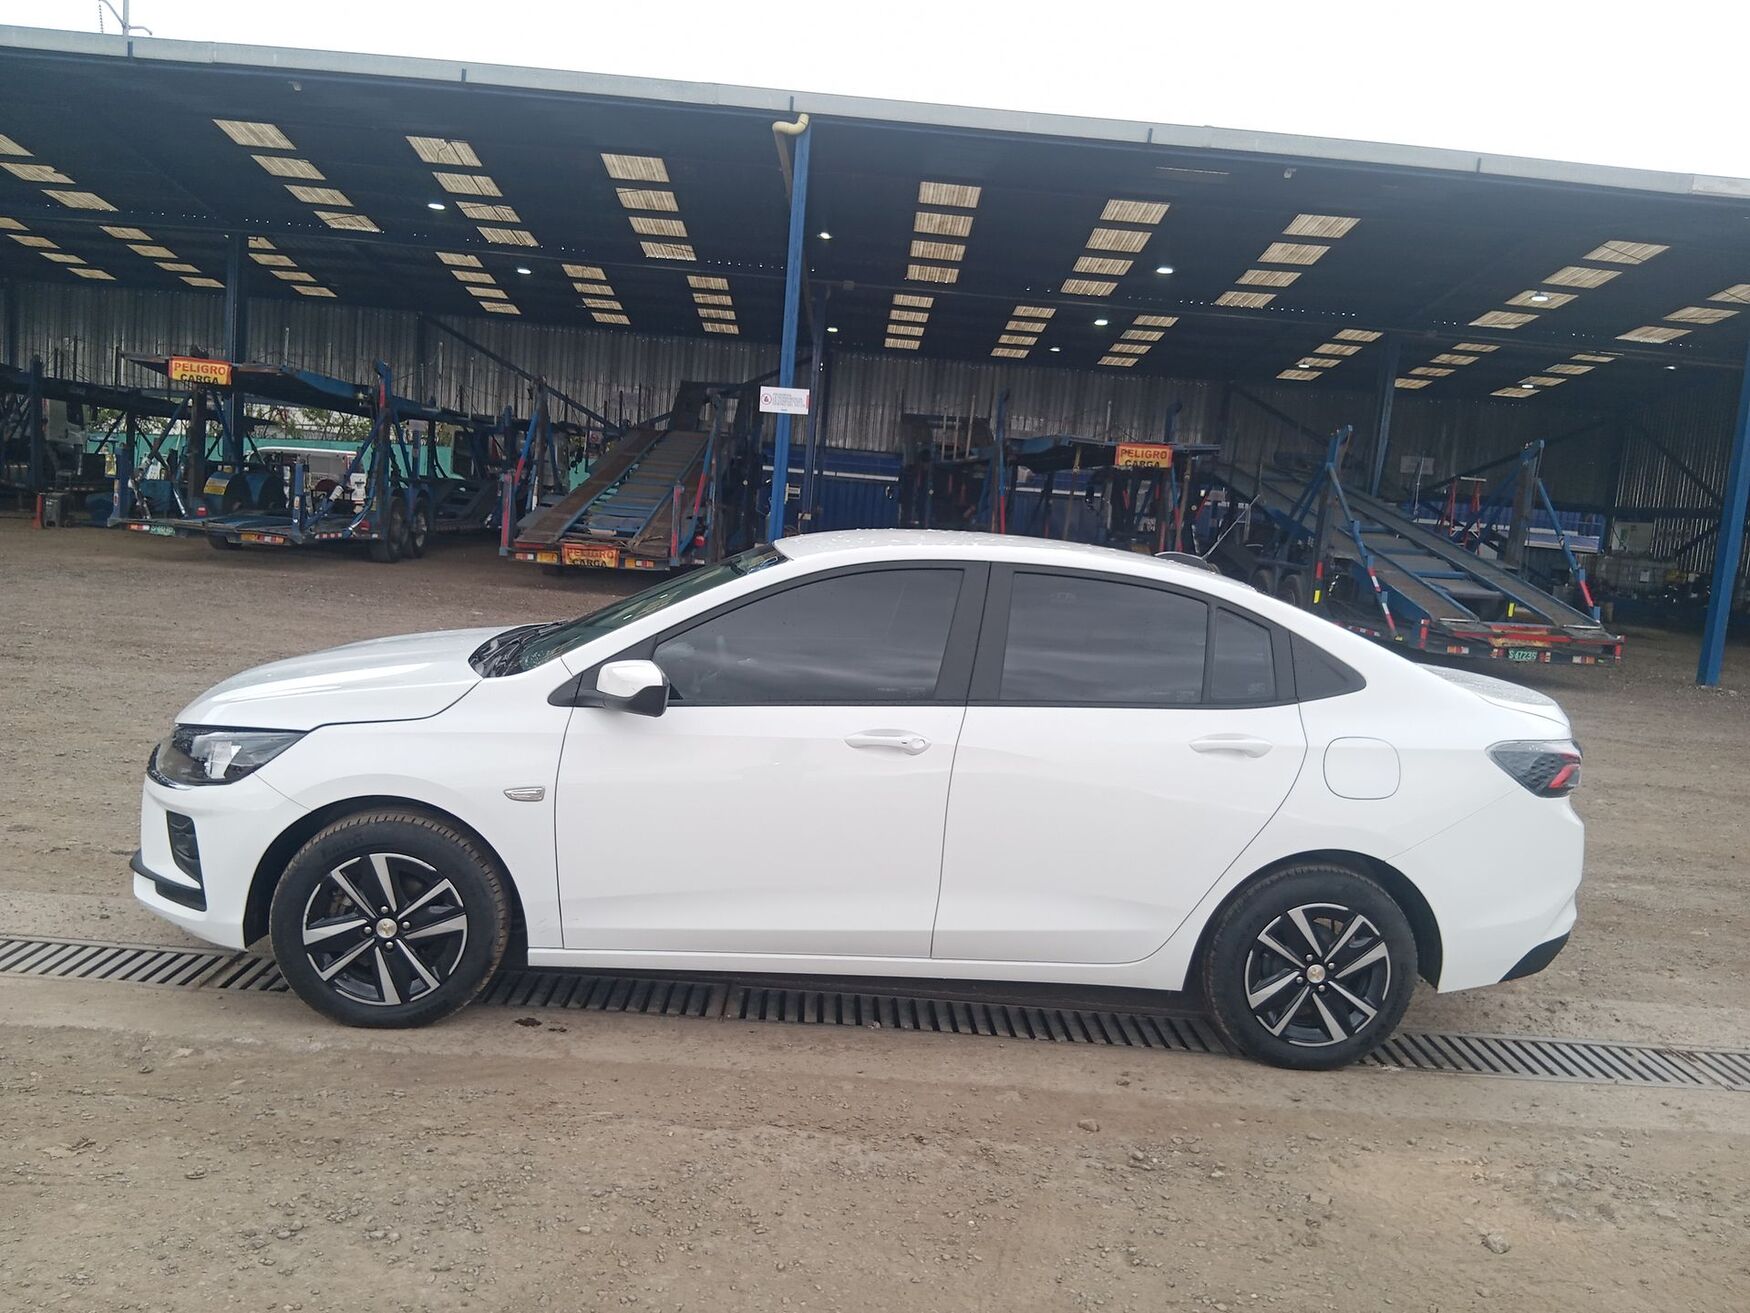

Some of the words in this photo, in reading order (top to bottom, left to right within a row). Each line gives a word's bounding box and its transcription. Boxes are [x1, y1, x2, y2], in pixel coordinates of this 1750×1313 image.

[174, 362, 226, 375] PELIGRO
[181, 374, 219, 384] CARGA
[1120, 449, 1167, 460] PELIGRO
[1124, 459, 1160, 469] CARGA
[567, 549, 614, 559] PELIGRO
[572, 559, 607, 567] CARGA
